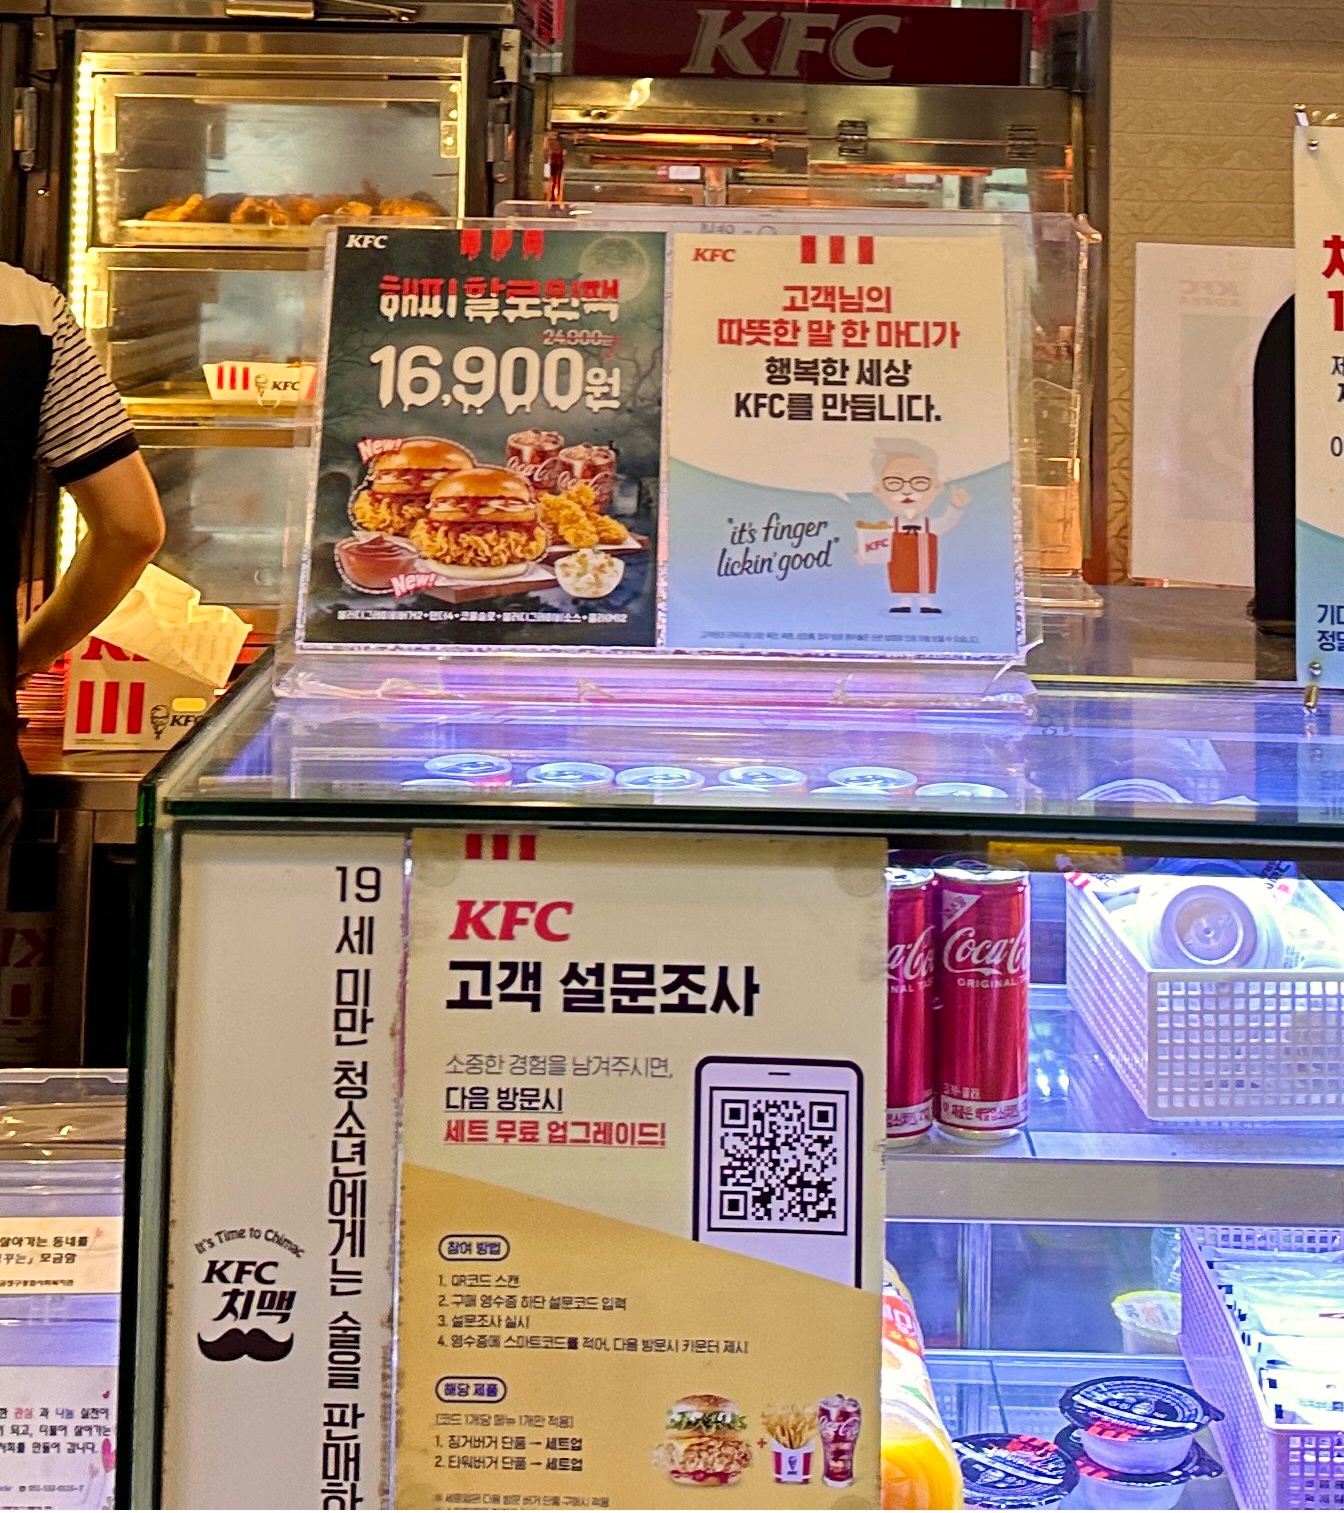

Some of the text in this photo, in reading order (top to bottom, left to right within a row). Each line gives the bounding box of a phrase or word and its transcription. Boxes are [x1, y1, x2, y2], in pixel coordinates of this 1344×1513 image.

[680, 8, 902, 81] KFC
[346, 234, 388, 249] KFC
[693, 247, 737, 263] KFC
[378, 274, 620, 326] 해피 할로윈팩
[782, 285, 893, 314] 고객님의
[717, 317, 960, 350] 따뜻한 말 한 마디가
[271, 380, 301, 391] KFC
[369, 344, 621, 415] 16,900원
[764, 356, 912, 388] 행복한 세상
[734, 392, 942, 423] KFC를 만듭니다.
[761, 511, 829, 549] finger
[864, 539, 890, 553] KFC
[335, 865, 382, 903] 19
[334, 915, 375, 955] 세
[448, 899, 574, 942] KFC
[445, 959, 761, 1018] 고객 설문조사
[957, 977, 1018, 989] ORIGINAL
[333, 968, 375, 1047] 미만
[445, 1053, 674, 1079] 소중한 경험을 남겨주시면,
[445, 1085, 564, 1112] 다음 방문시
[444, 1118, 667, 1147] 세트 무료 업그레이드!
[328, 1060, 370, 1297] 청소년에게는
[214, 1227, 247, 1245] Time
[249, 1226, 262, 1241] to
[201, 1260, 280, 1285] KFC
[212, 1288, 297, 1324] 치맥
[328, 1310, 362, 1390] 술을
